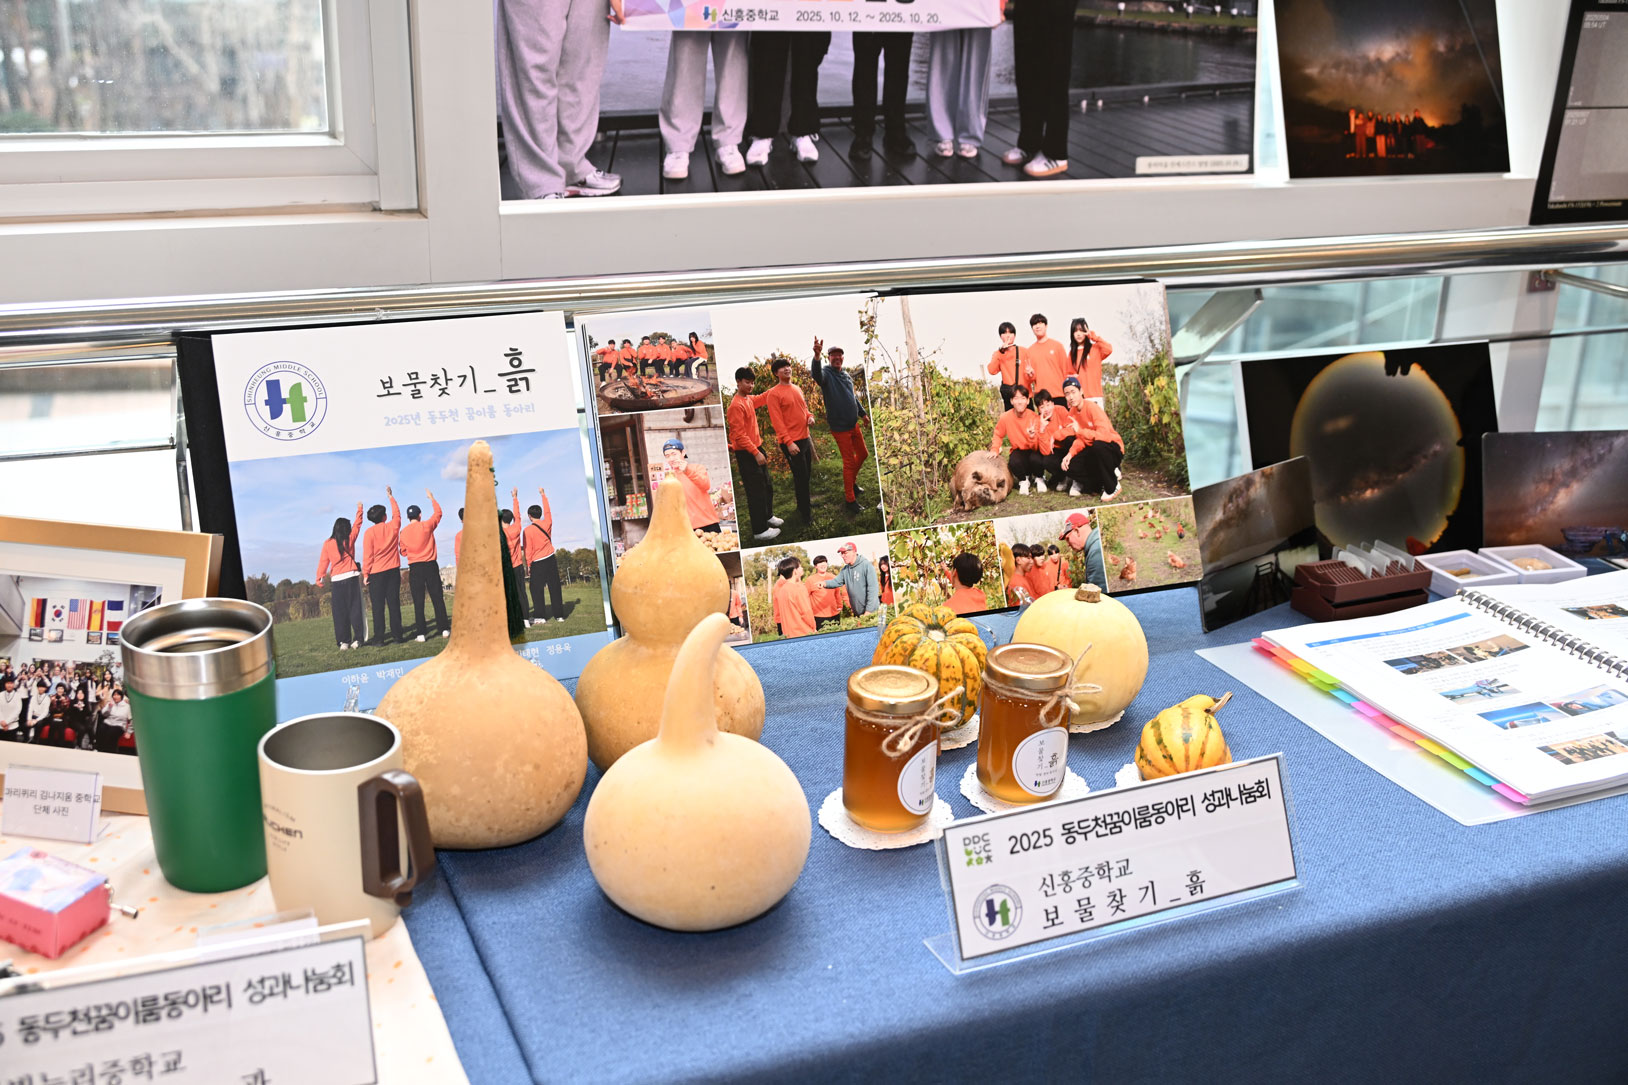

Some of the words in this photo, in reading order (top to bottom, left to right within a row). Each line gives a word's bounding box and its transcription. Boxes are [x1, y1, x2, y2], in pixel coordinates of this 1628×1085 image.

[722, 8, 780, 22] 신흥중학교
[796, 11, 825, 22] 2025.
[830, 12, 844, 22] 10.
[848, 12, 862, 23] 12.
[879, 12, 906, 23] 2025.
[910, 13, 924, 24] 10.
[926, 13, 942, 24] 20.
[247, 367, 272, 403] SHINHEUNG
[273, 364, 301, 373] MIDDLE
[303, 370, 324, 396] SCHOOL
[376, 347, 536, 400] 보물찾기_흙
[384, 411, 421, 427] 2025년
[427, 408, 460, 425] 동두천
[503, 402, 536, 418] 동아리
[52, 806, 69, 817] 사진
[1008, 828, 1054, 855] 2025
[1060, 794, 1196, 846] 동두천꿈이룸동아리
[1201, 777, 1272, 813] 성과나눔회
[963, 832, 991, 847] DDC
[243, 960, 356, 1005] 성과나눔회
